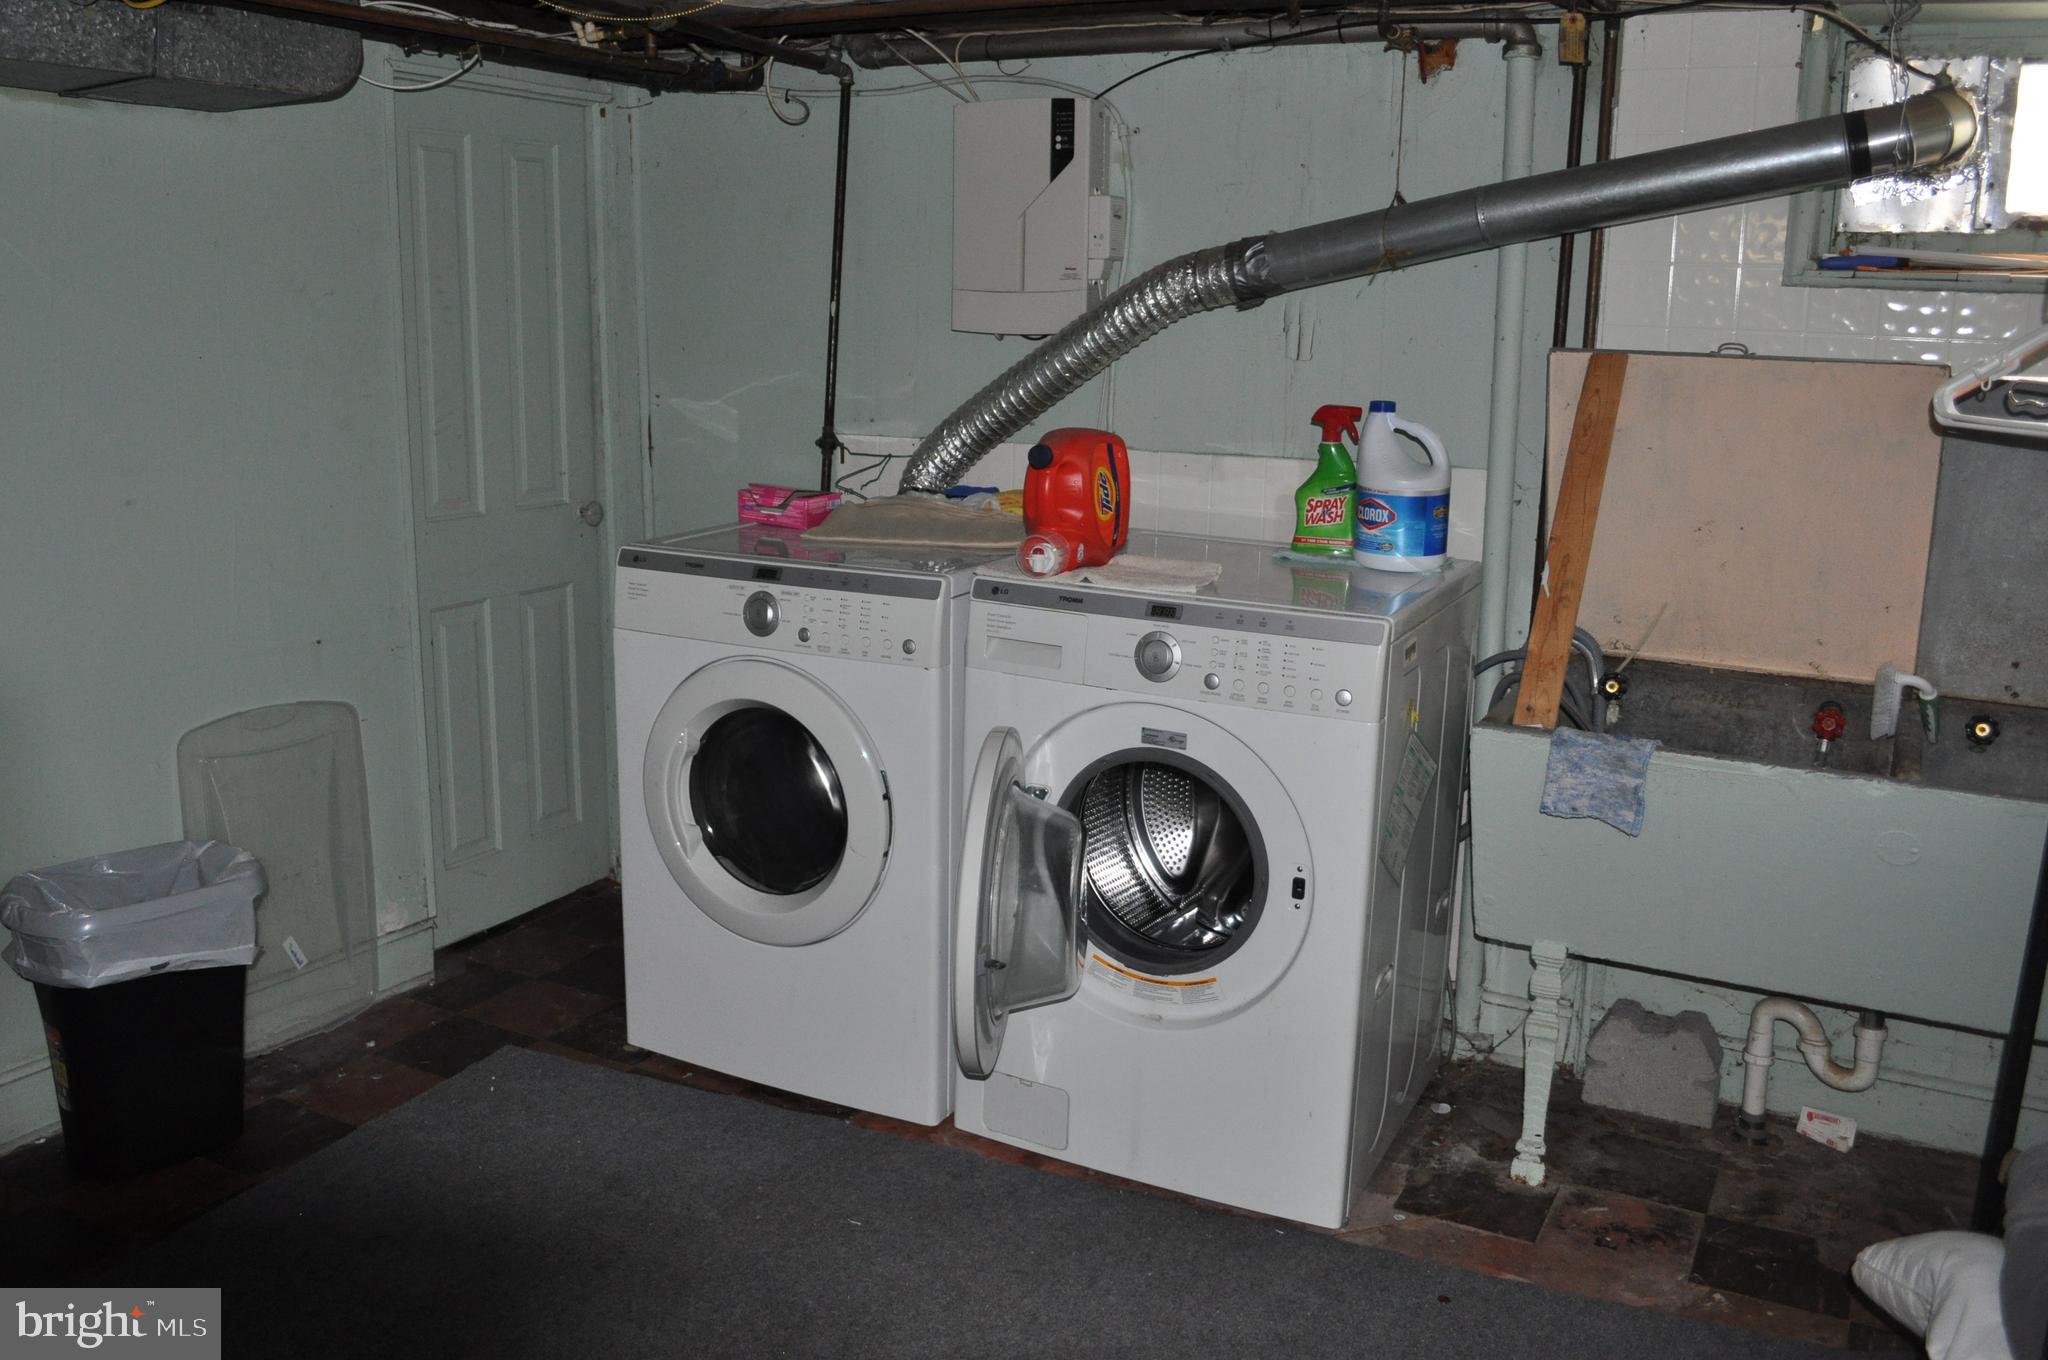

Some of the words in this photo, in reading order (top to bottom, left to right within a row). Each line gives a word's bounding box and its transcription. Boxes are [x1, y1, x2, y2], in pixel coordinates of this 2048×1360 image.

[1099, 471, 1113, 516] Tide
[1306, 496, 1347, 513] SPRAY
[1305, 510, 1344, 525] WASH
[1358, 505, 1389, 523] CLOROX
